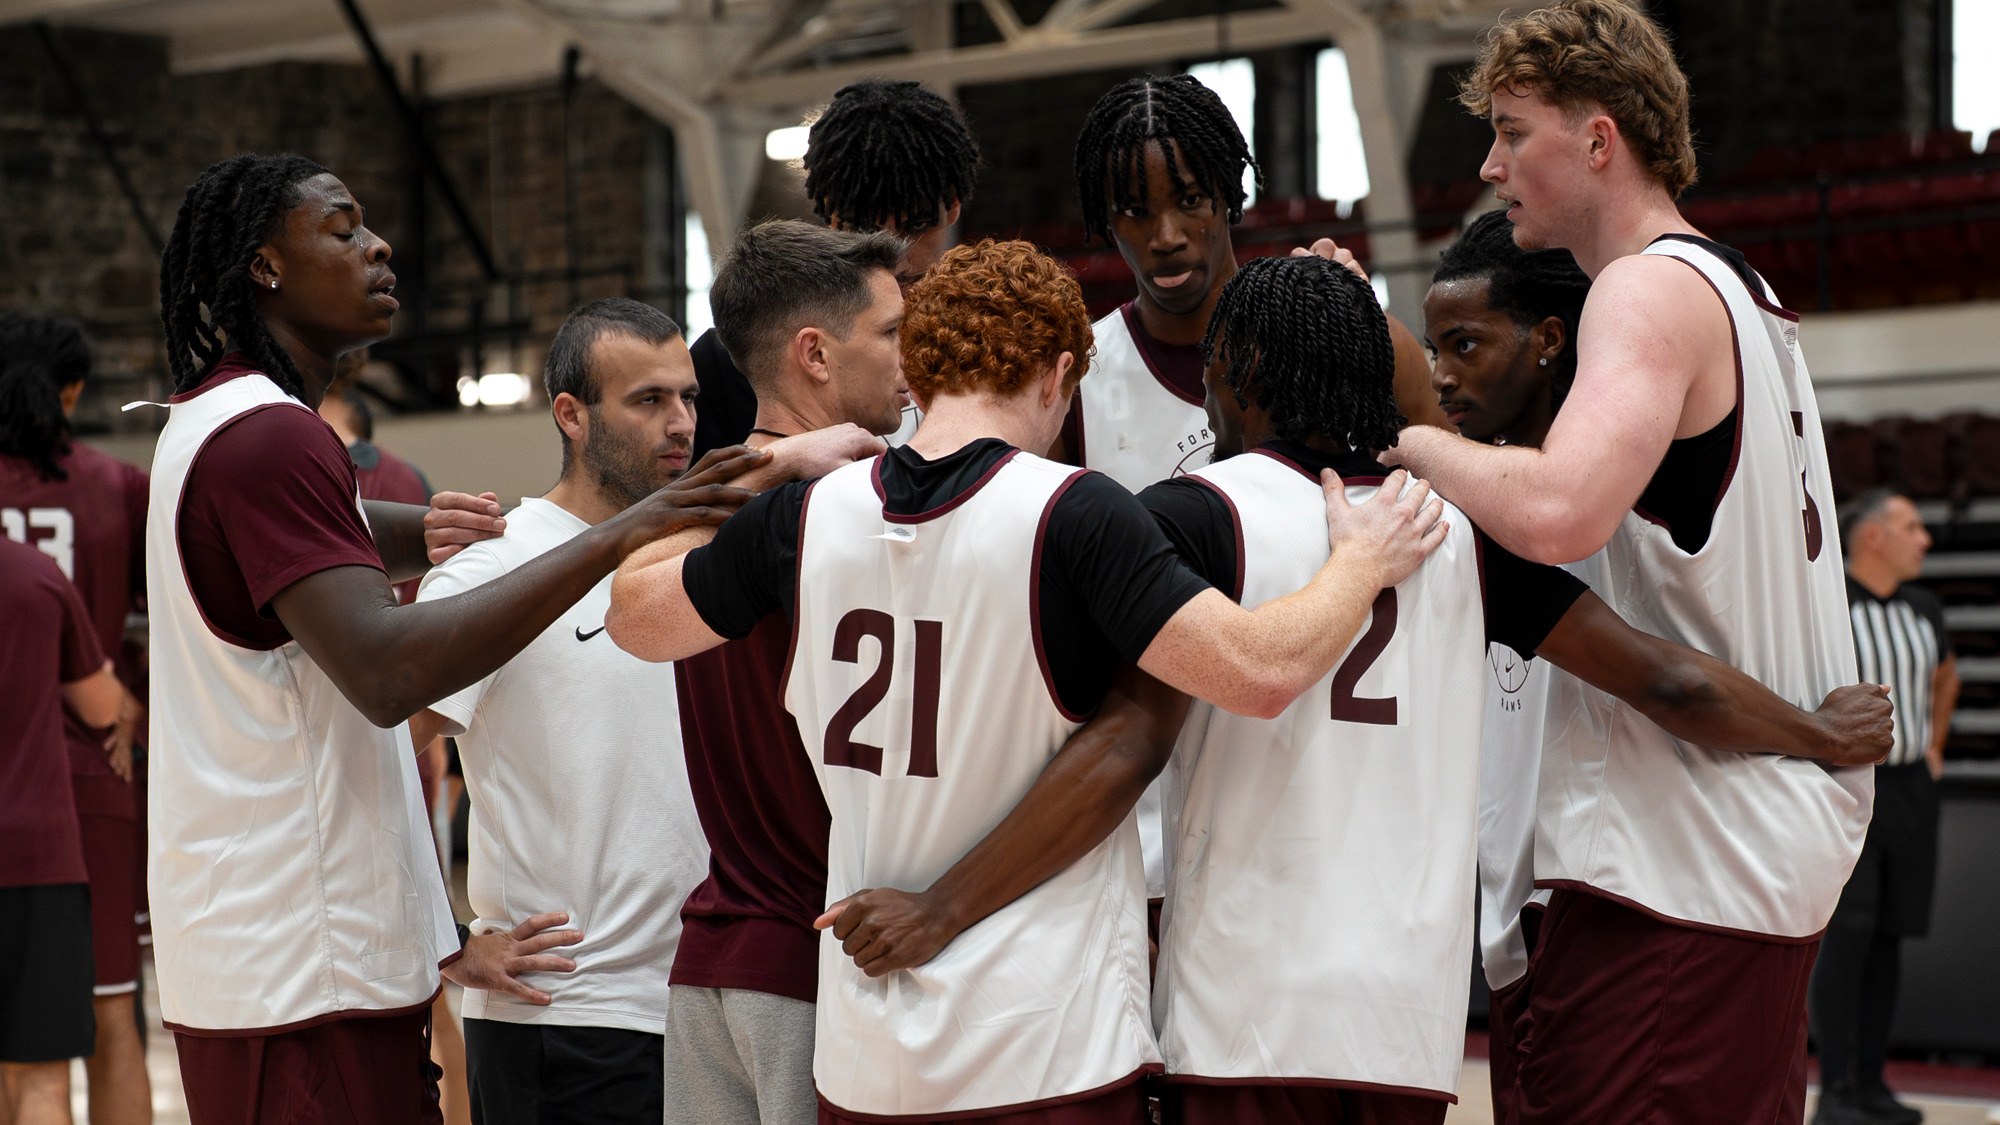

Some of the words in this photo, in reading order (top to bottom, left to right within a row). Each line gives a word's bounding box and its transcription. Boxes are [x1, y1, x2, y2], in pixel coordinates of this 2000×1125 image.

[1176, 428, 1209, 453] FOR
[823, 608, 943, 778] 21
[1330, 585, 1398, 725] 2
